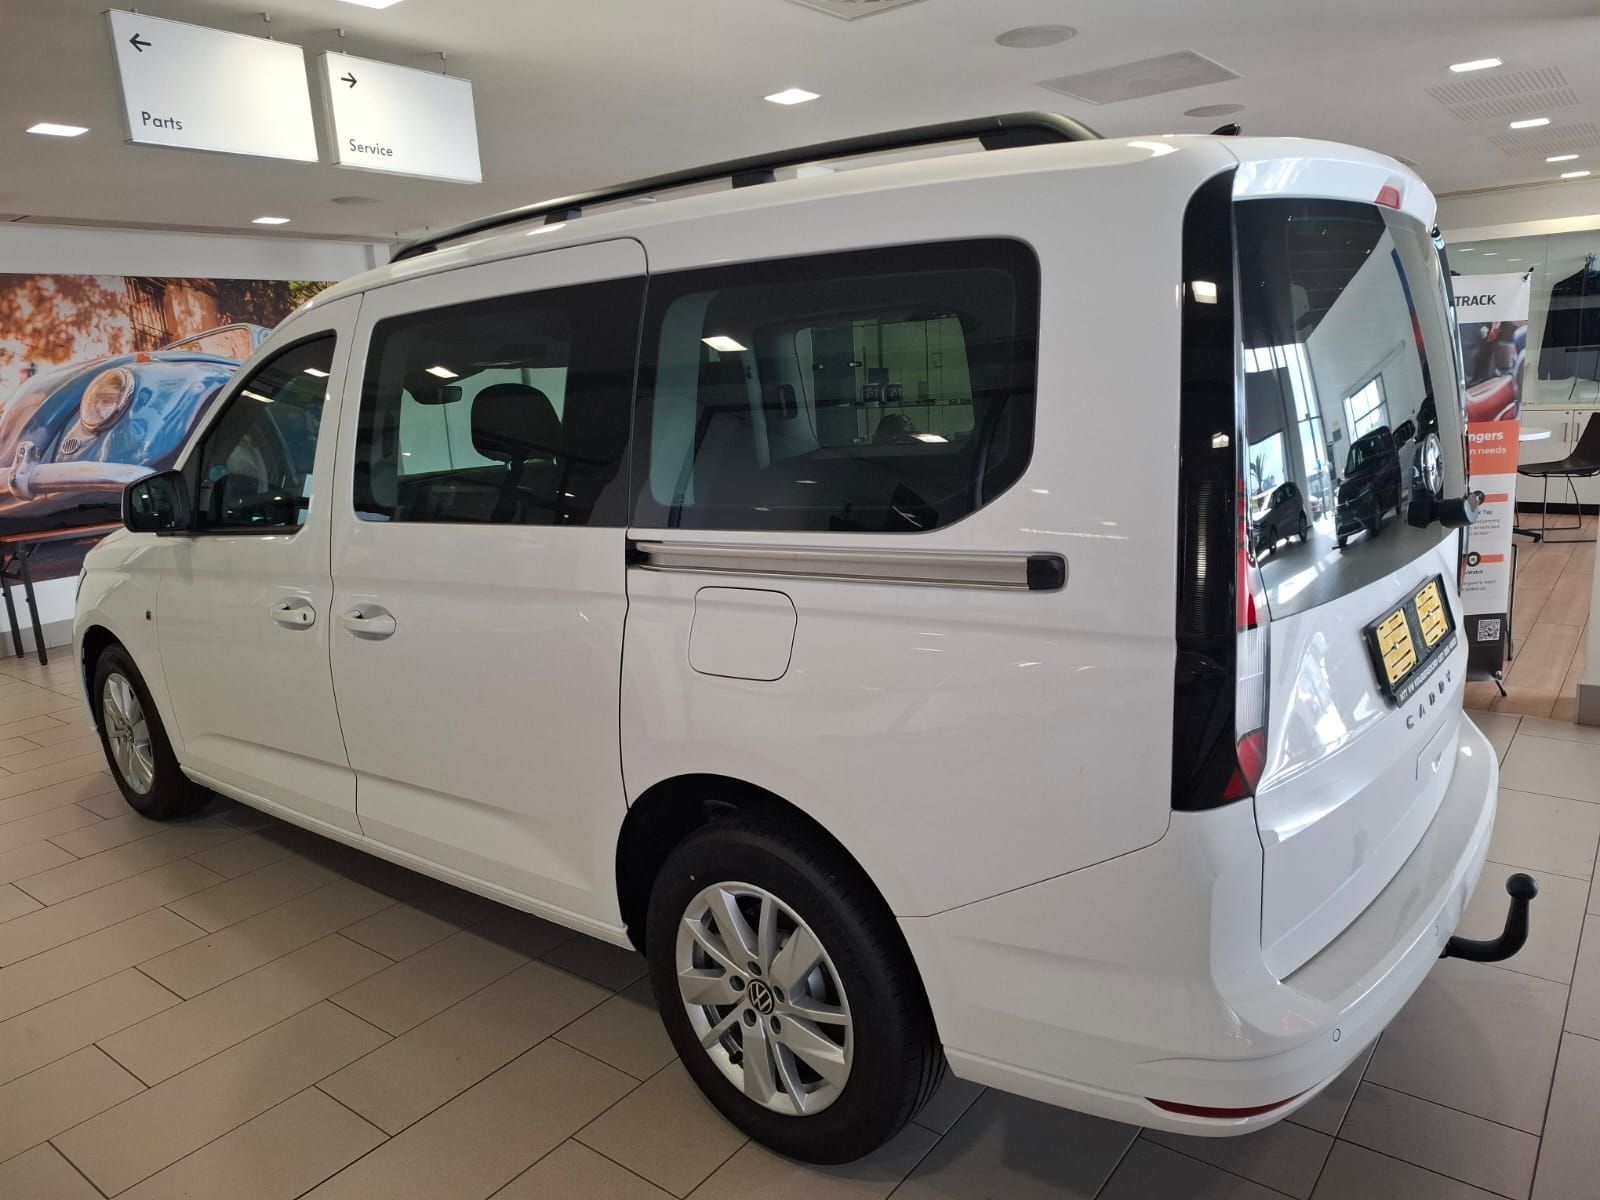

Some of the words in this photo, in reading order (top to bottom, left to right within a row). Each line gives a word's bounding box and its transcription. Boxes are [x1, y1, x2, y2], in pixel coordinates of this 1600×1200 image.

[141, 111, 183, 131] Parts
[349, 139, 393, 157] Service
[1454, 294, 1496, 307] TRACK
[1478, 446, 1507, 455] needs
[1406, 670, 1451, 730] CADDY
